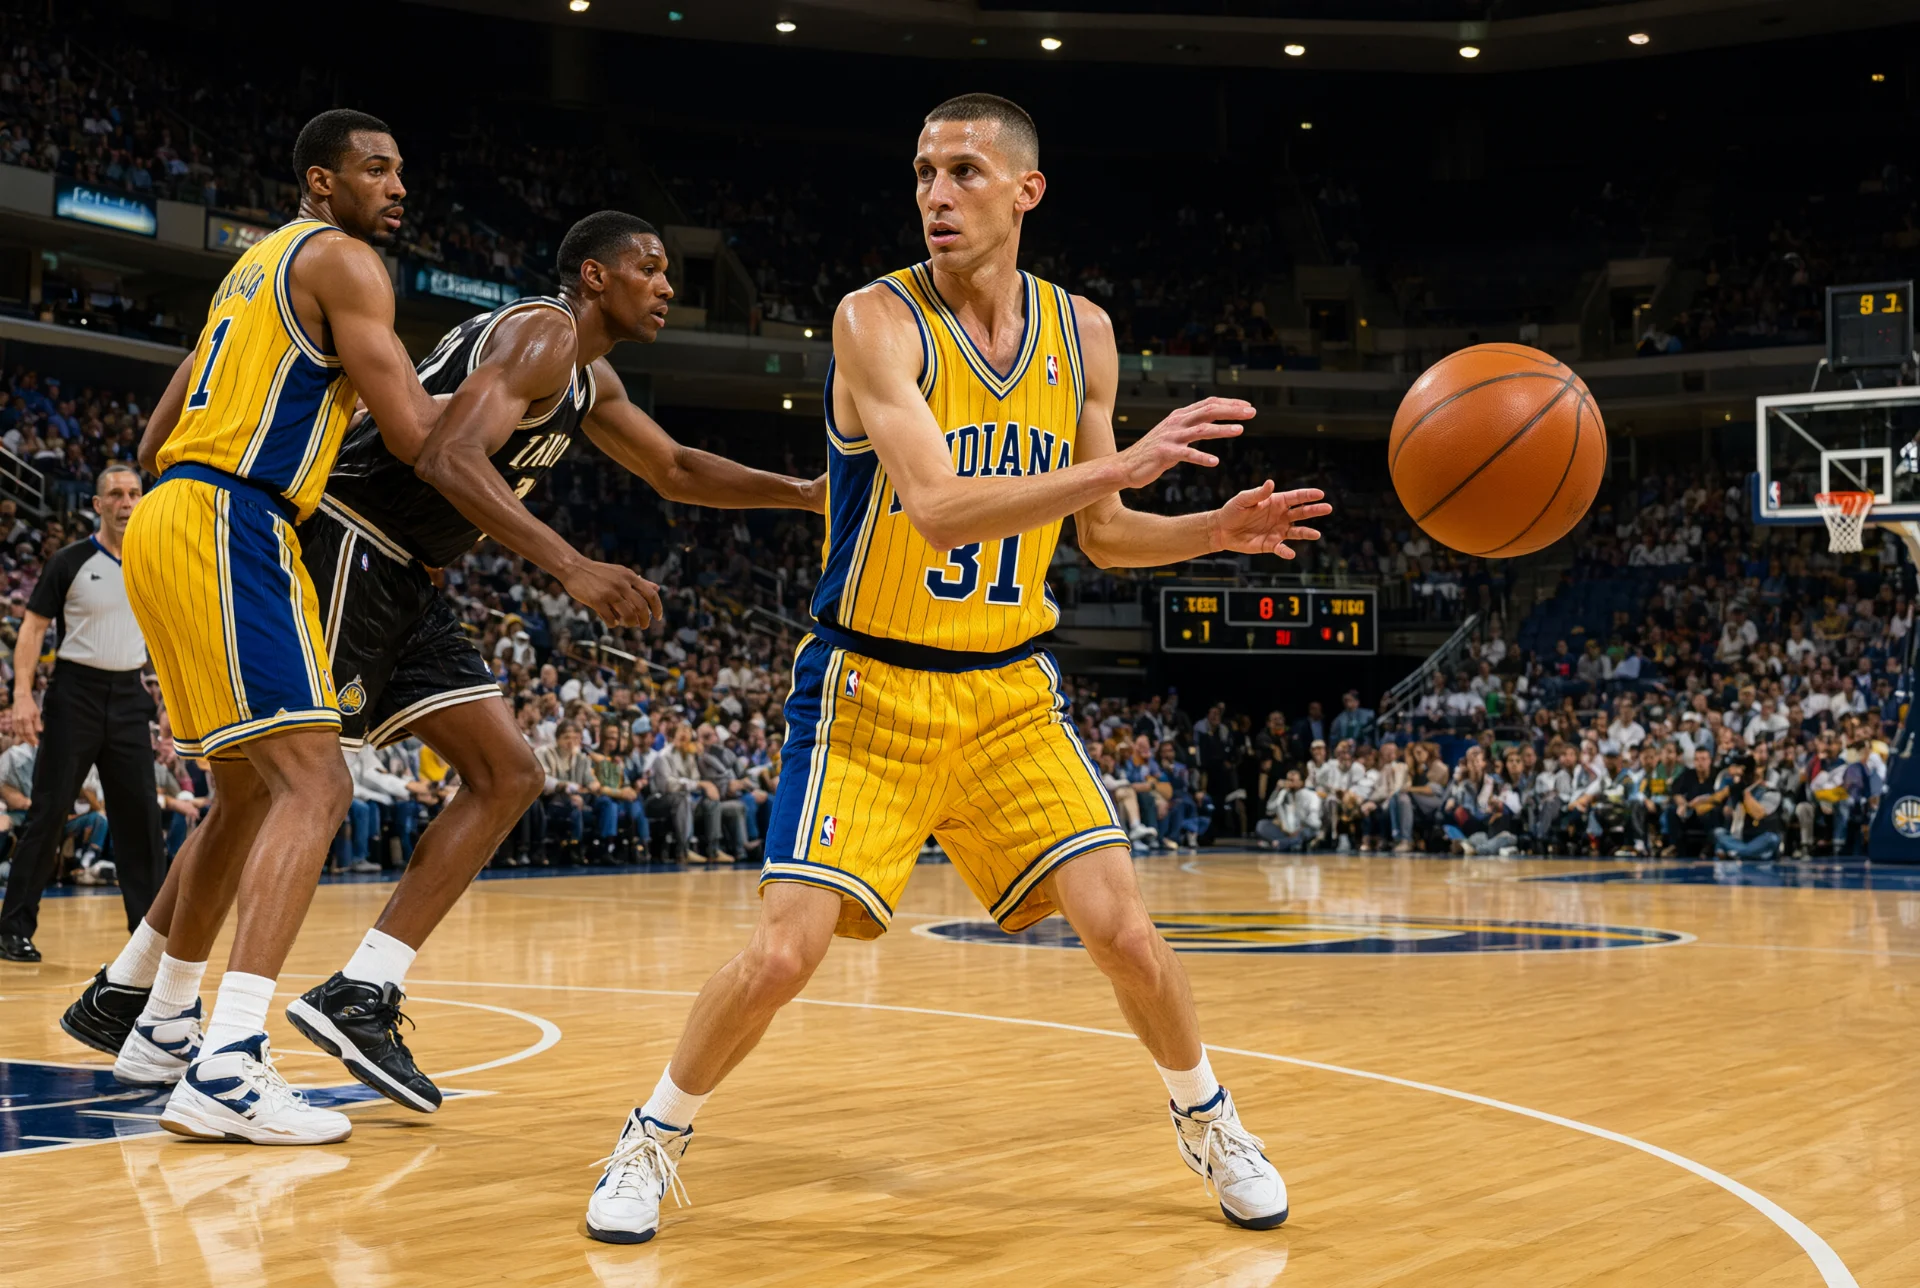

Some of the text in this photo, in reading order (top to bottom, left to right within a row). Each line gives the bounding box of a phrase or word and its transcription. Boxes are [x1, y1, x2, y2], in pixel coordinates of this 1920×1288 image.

[186, 316, 234, 411] 1
[943, 421, 1074, 479] DIANA
[924, 533, 1024, 606] 31
